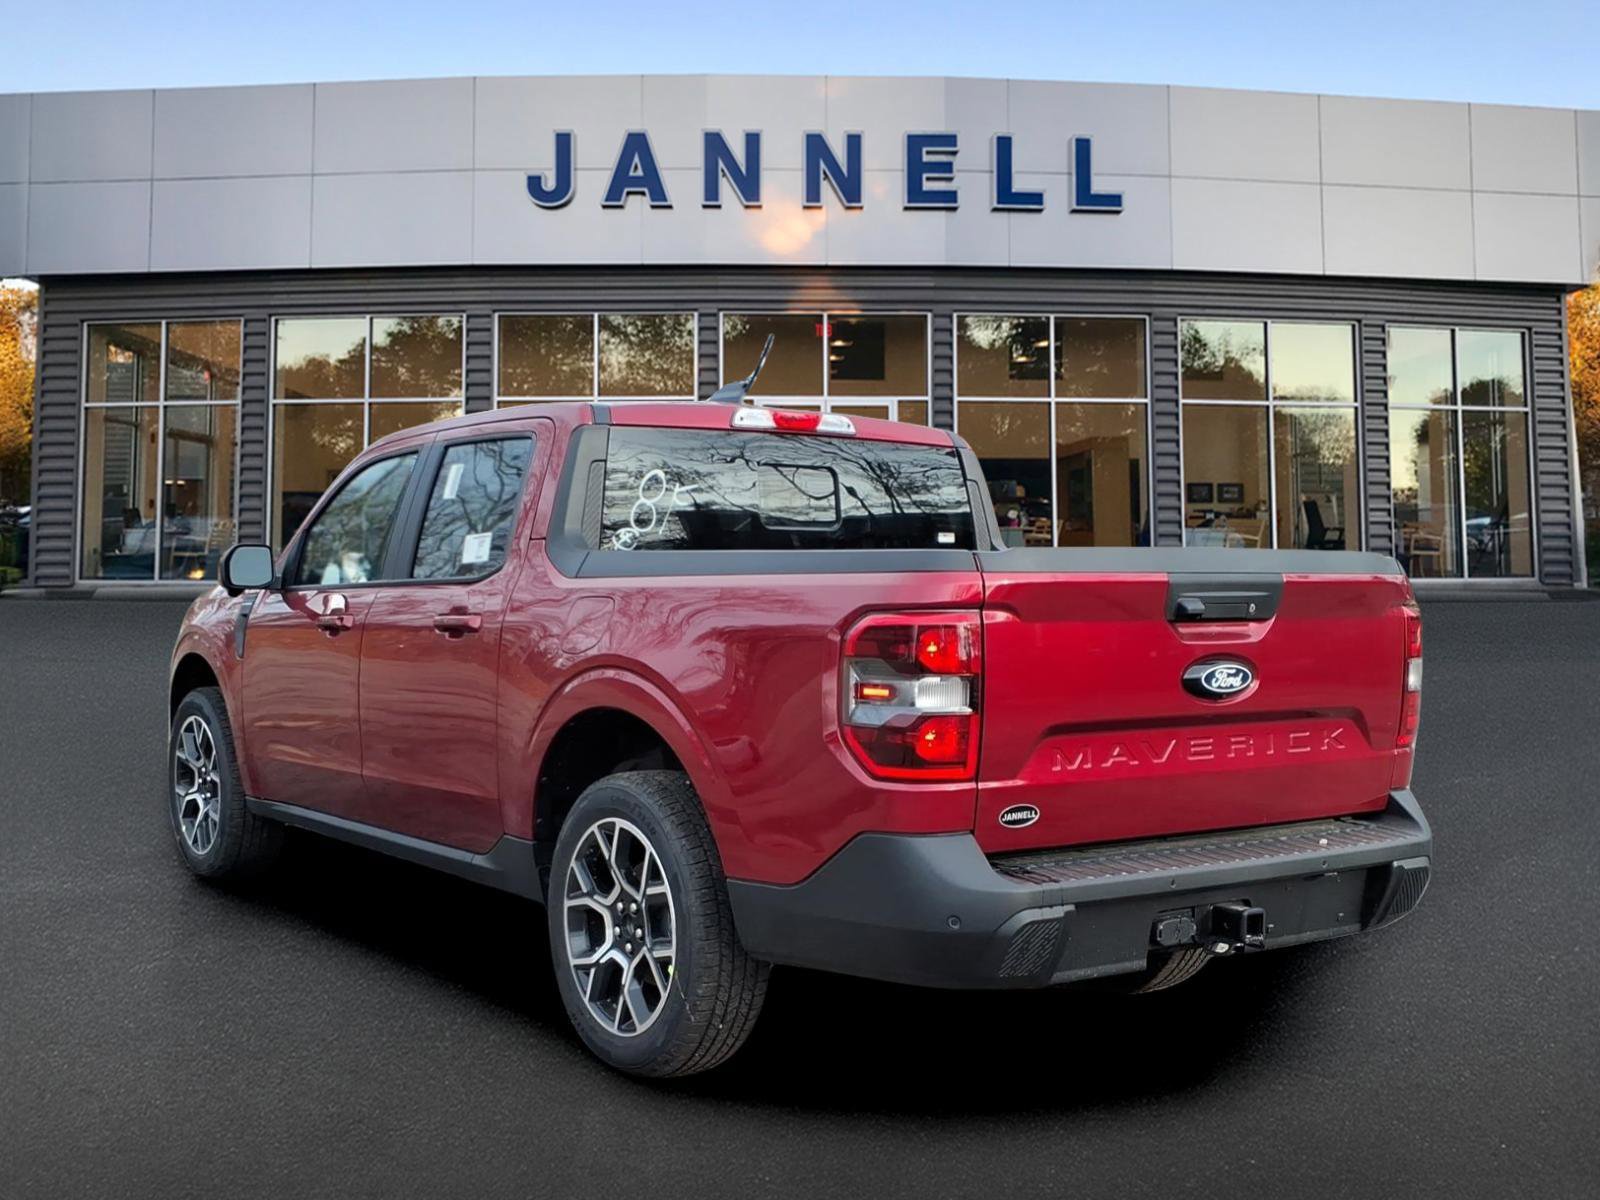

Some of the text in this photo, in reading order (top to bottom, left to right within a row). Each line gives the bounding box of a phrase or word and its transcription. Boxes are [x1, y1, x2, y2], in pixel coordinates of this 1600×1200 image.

[525, 129, 1124, 213] JANNELL
[1211, 668, 1244, 688] Ford
[1051, 727, 1347, 772] MAVERICK
[1001, 810, 1036, 822] JANNELL
